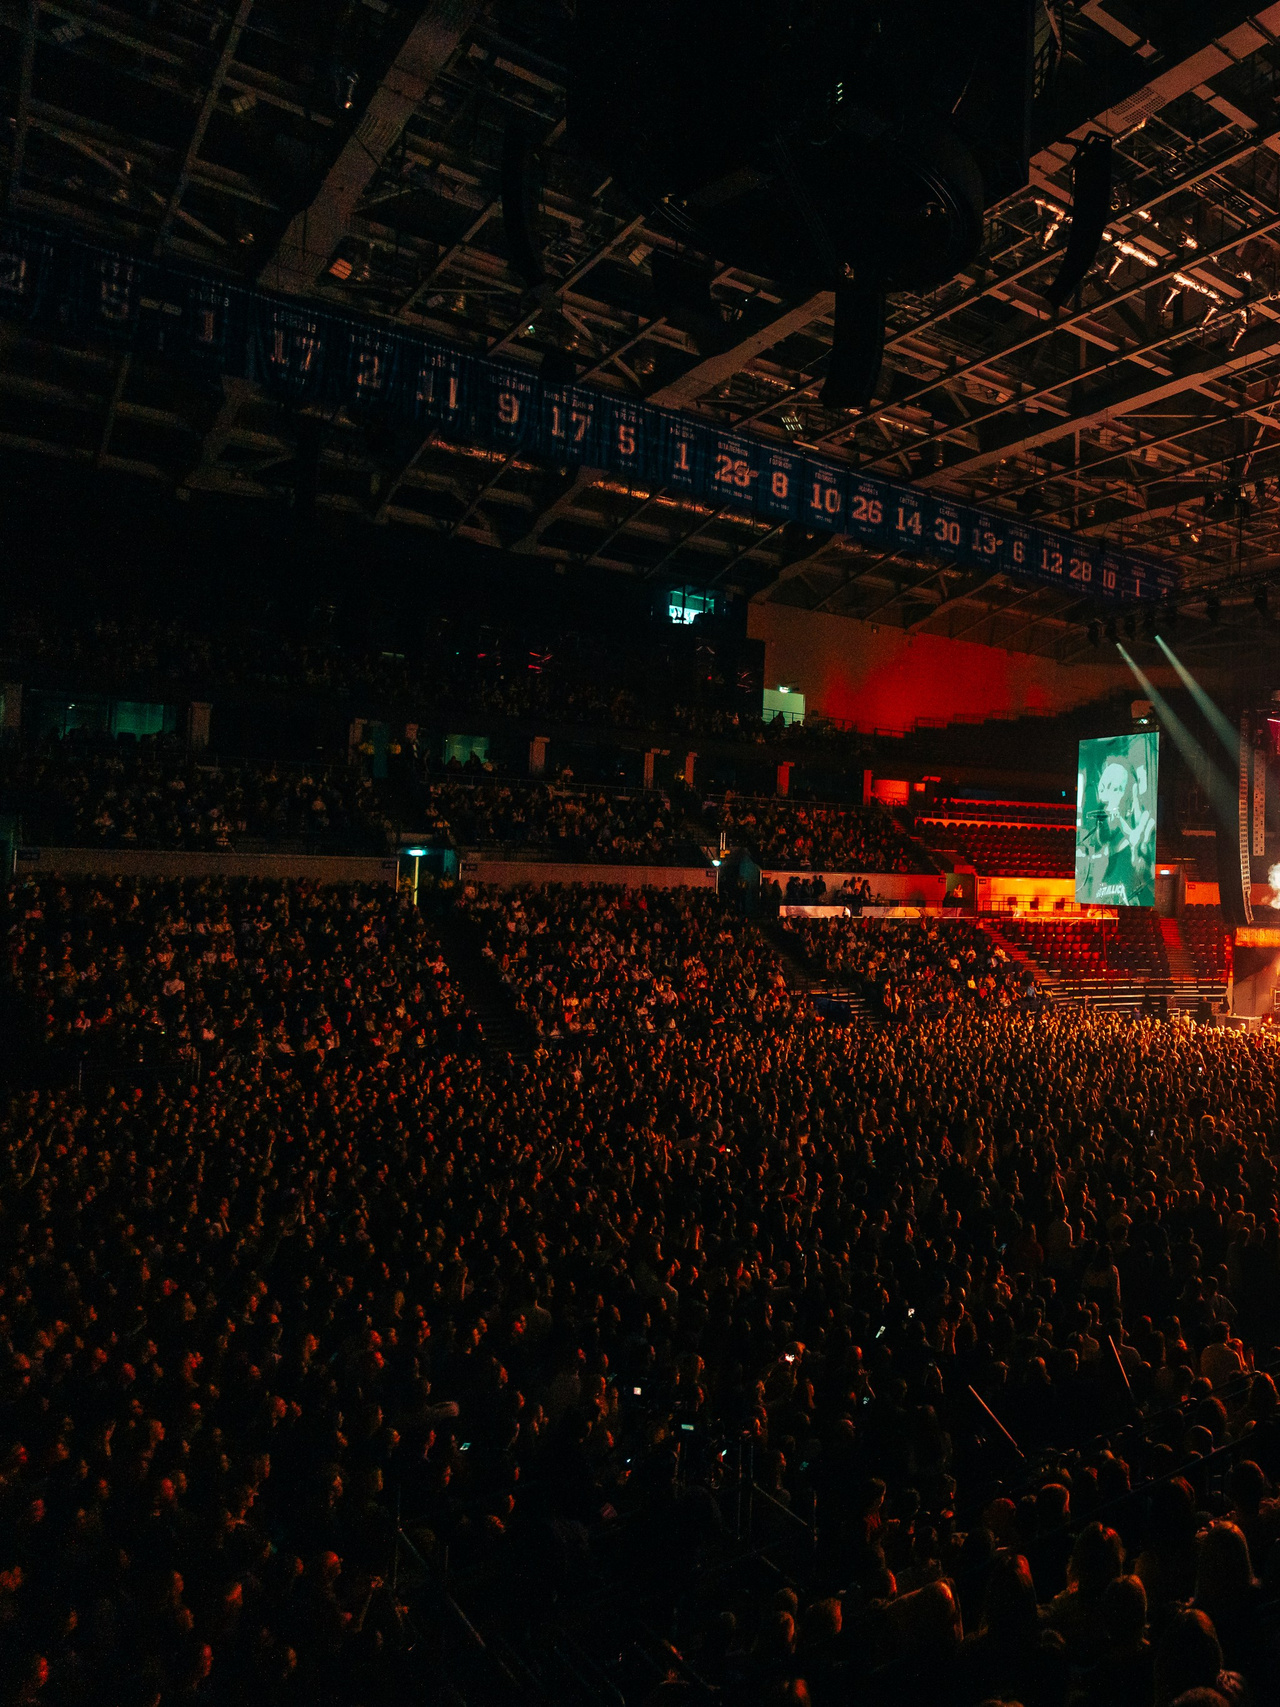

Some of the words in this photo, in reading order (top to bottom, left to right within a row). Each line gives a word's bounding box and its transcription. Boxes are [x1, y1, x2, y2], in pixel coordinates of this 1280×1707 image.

[497, 392, 520, 424] 9
[551, 404, 592, 442] 17
[617, 423, 636, 455] 5
[674, 441, 691, 472] 1
[771, 470, 789, 499] 8
[809, 482, 842, 515] 10
[851, 494, 884, 525] 26
[895, 506, 923, 536] 14
[933, 516, 961, 546] 30
[971, 528, 997, 555] 13
[1039, 547, 1064, 576] 12
[1068, 556, 1093, 583] 28
